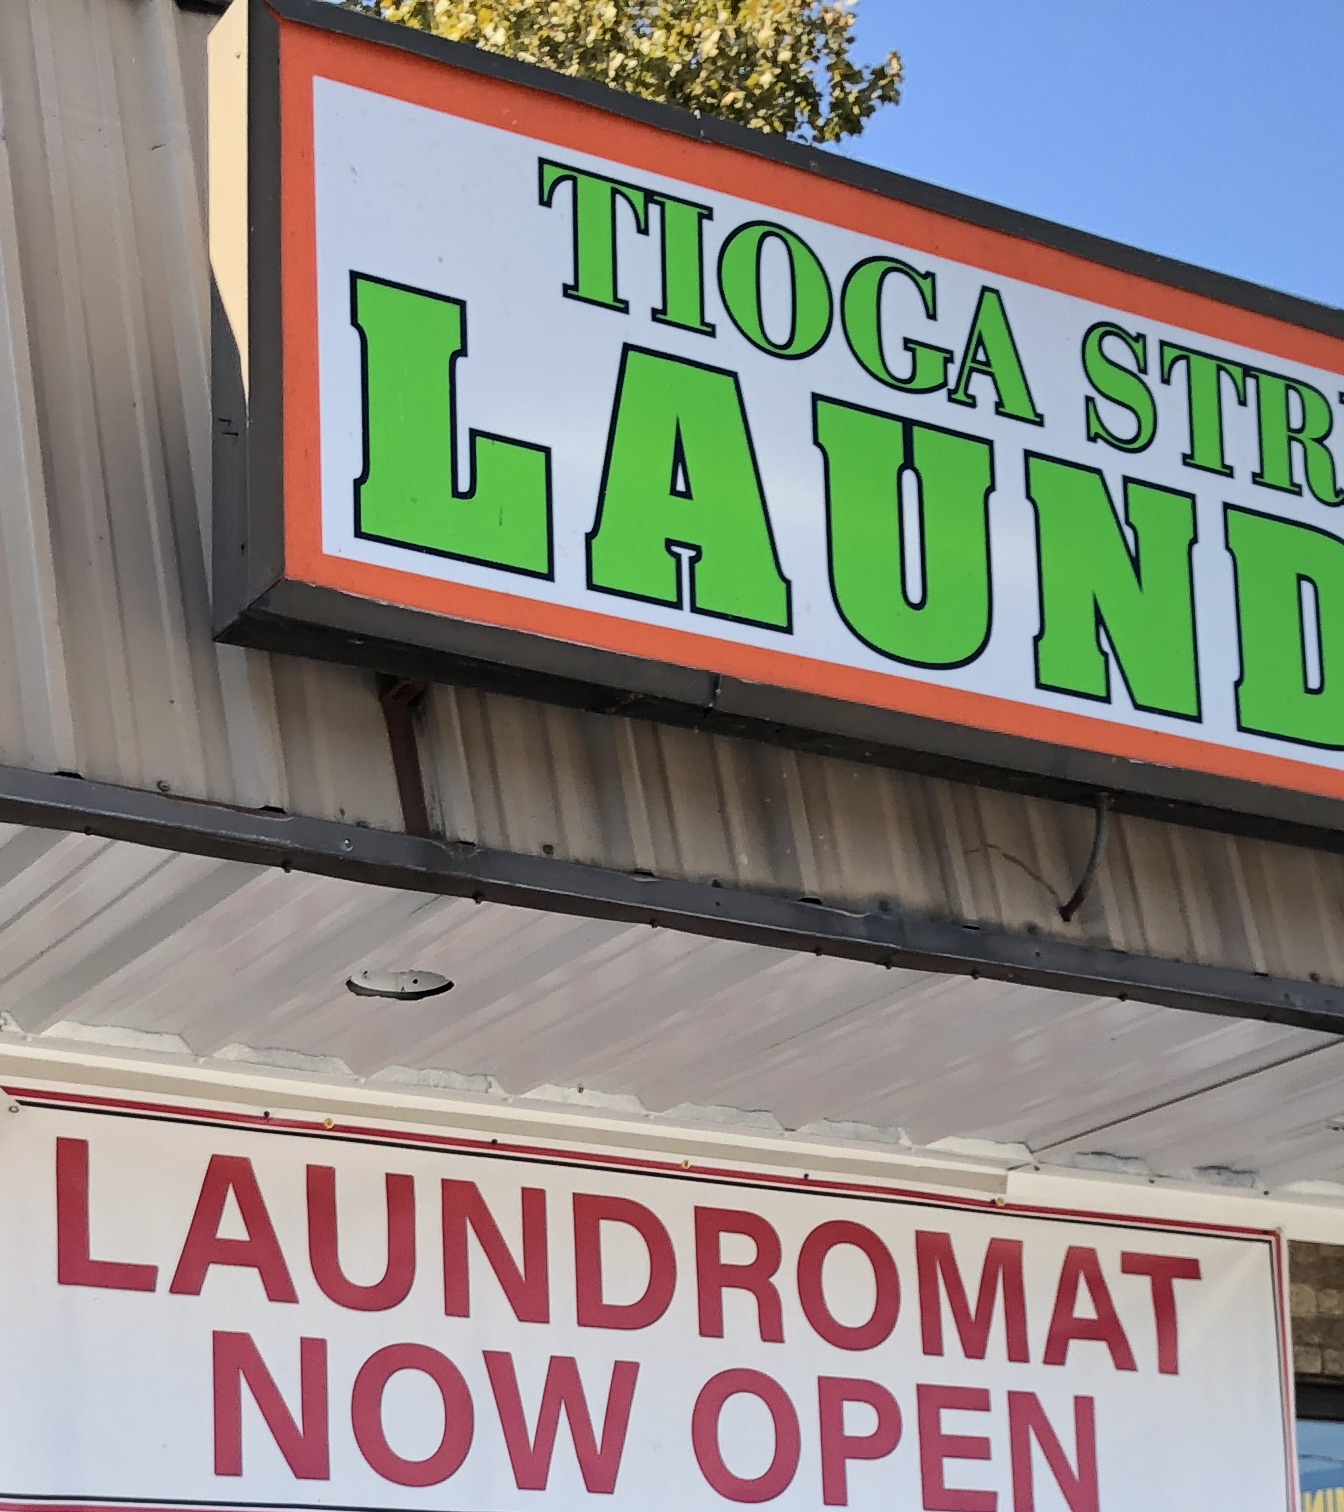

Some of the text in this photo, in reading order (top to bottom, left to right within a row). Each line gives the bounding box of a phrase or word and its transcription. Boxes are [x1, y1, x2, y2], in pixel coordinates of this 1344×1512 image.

[537, 157, 1044, 425] TIOGA
[55, 1136, 1202, 1377] LAUNDROMAT
[211, 1330, 641, 1495] NOW
